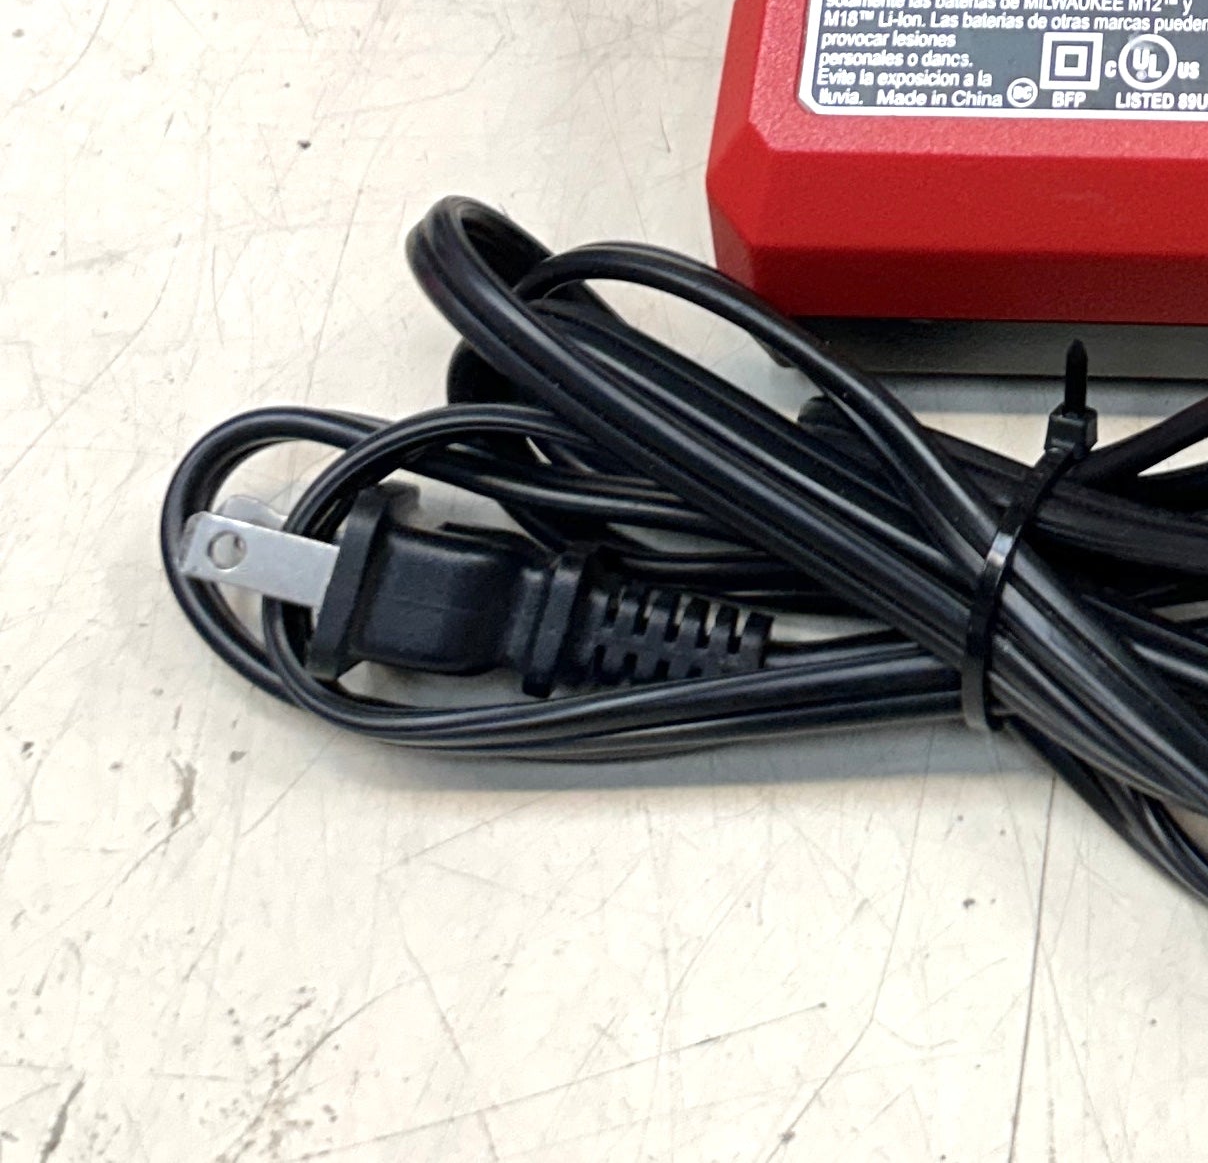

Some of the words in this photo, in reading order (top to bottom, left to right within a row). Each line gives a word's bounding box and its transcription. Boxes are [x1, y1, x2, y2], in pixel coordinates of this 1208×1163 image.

[1183, 0, 1192, 16] y
[930, 12, 958, 28] Las
[1028, 13, 1047, 29] de
[1051, 14, 1089, 30] otras
[1094, 16, 1150, 30] marcas
[821, 33, 889, 49] provocar
[892, 31, 956, 47] lesiones
[819, 50, 903, 69] personales
[908, 54, 918, 66] o
[860, 69, 874, 85] la
[963, 73, 974, 86] a
[978, 71, 992, 86] la
[877, 90, 927, 105] Made
[931, 90, 947, 105] in
[952, 90, 1003, 106] China
[1116, 93, 1174, 109] LISTED
